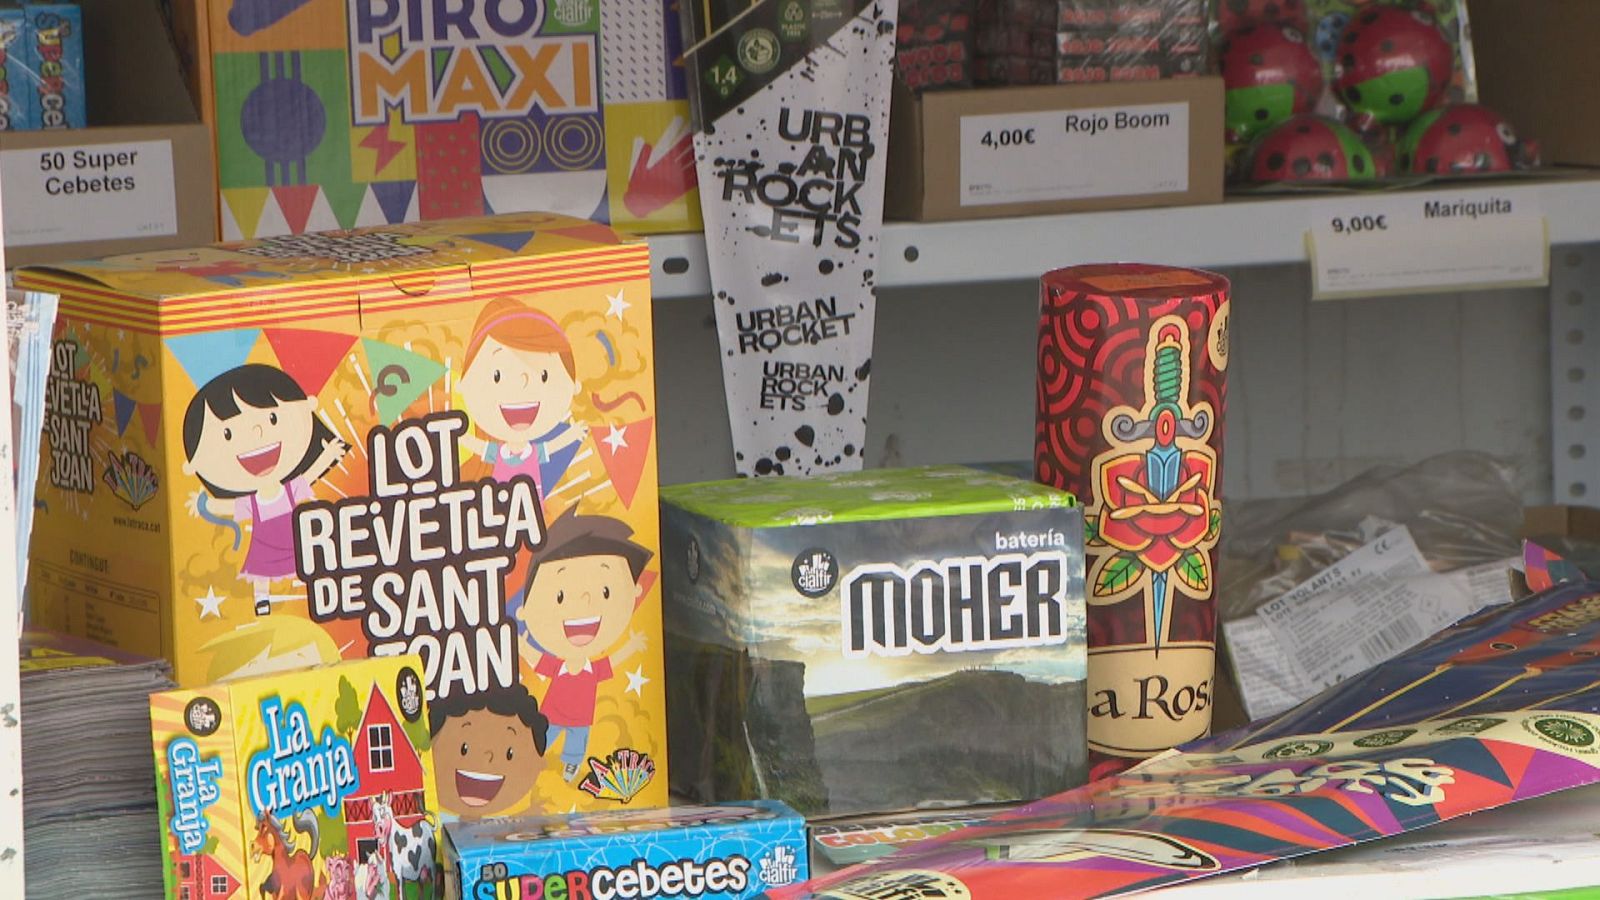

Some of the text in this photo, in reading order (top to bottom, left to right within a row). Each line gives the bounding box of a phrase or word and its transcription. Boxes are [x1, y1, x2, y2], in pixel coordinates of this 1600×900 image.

[356, 0, 538, 43] PIRO
[357, 41, 593, 117] MAXI
[711, 65, 738, 85] 1.4
[778, 107, 872, 147] URB
[980, 128, 1036, 151] 4,00€
[1065, 111, 1171, 136] Rojo Boom
[40, 150, 138, 172] 50 Super
[795, 144, 870, 182] AN
[45, 175, 136, 196] Cebetes
[721, 168, 865, 216] ROCK
[770, 207, 862, 250] ETS
[1331, 214, 1388, 235] 9,00€
[1424, 197, 1513, 220] Mariquita
[735, 296, 838, 333] URBAN
[738, 312, 856, 355] ROCKET
[761, 377, 829, 398] ROCK
[763, 360, 844, 383] URBAN
[759, 392, 806, 412] ETS
[50, 415, 91, 457] SANT
[51, 450, 93, 493] JOAN
[373, 417, 463, 498] LOT
[996, 527, 1065, 551] batería
[313, 556, 510, 639] DE SANT
[846, 556, 1063, 655] MOHER
[375, 623, 512, 701] OAN
[264, 704, 313, 760] La
[197, 757, 219, 805] La
[250, 734, 357, 814] Granja
[171, 740, 206, 850] Granja
[482, 865, 506, 881] 50
